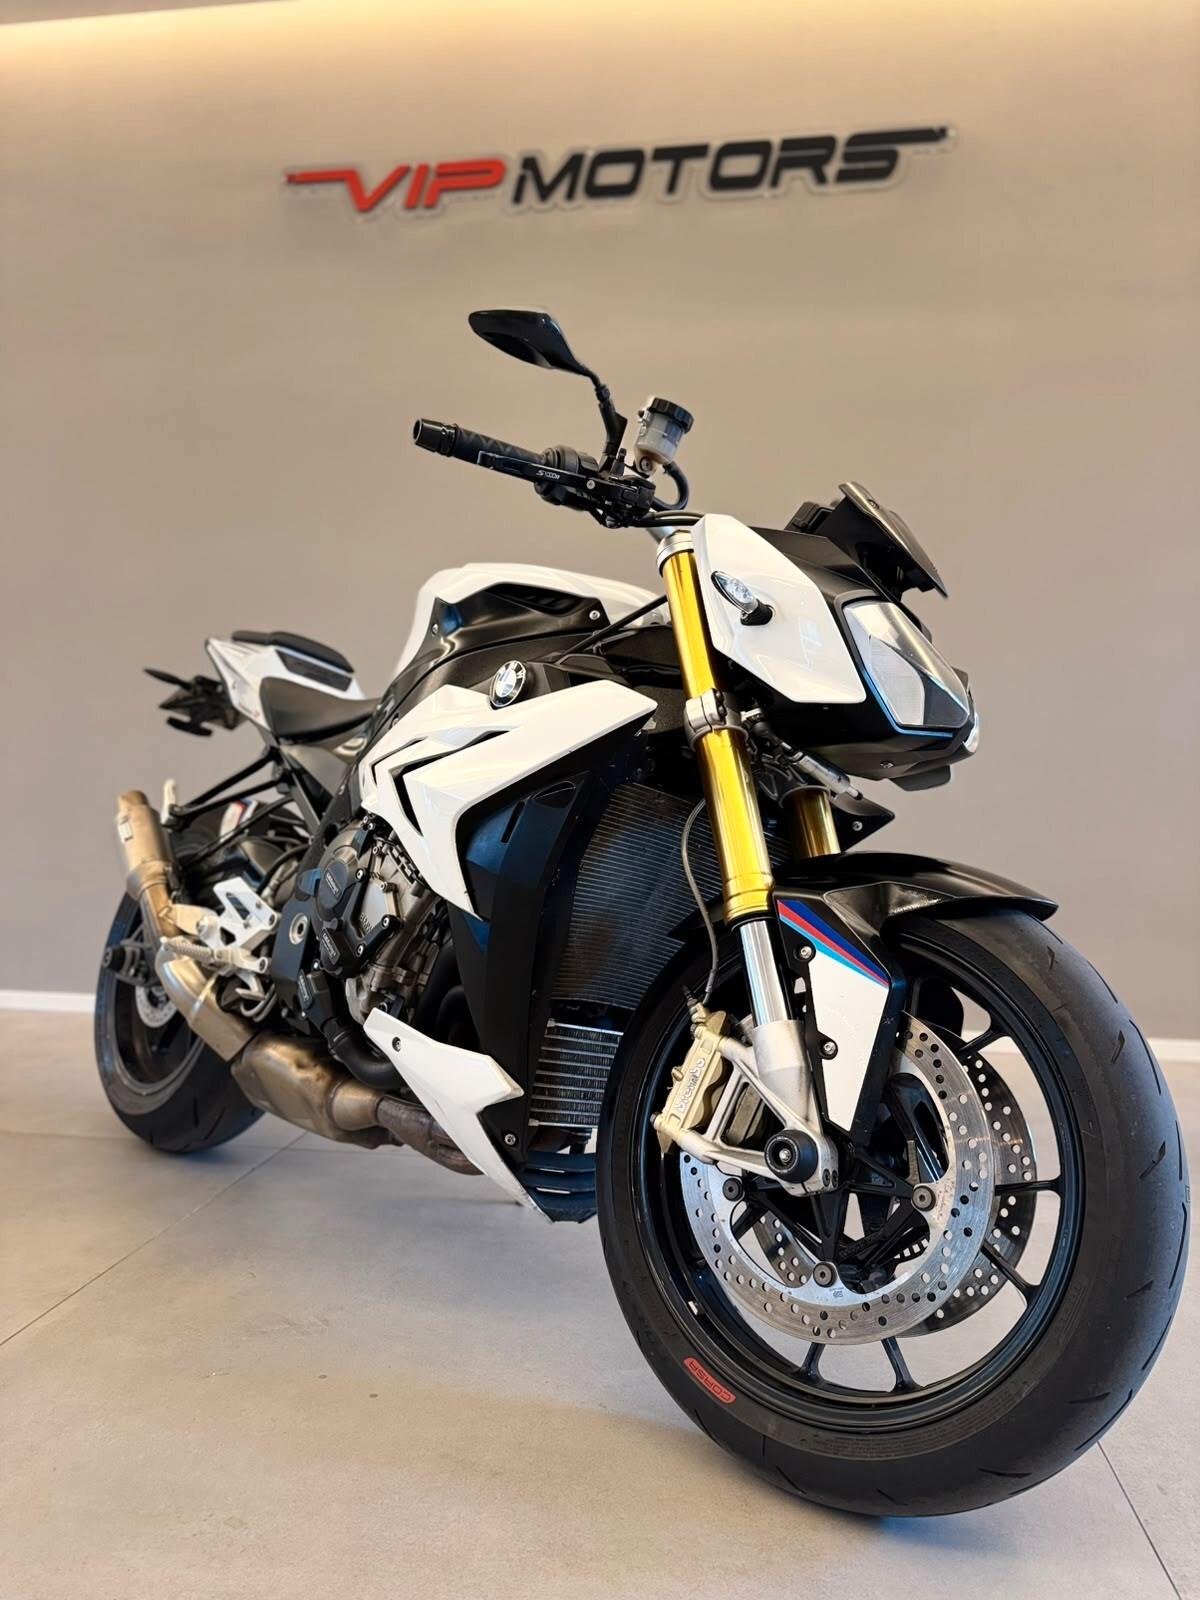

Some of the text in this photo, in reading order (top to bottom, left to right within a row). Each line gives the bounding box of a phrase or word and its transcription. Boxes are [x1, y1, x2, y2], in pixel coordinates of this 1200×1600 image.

[286, 126, 949, 214] VIP MOTORS
[686, 1359, 733, 1402] CORSA
